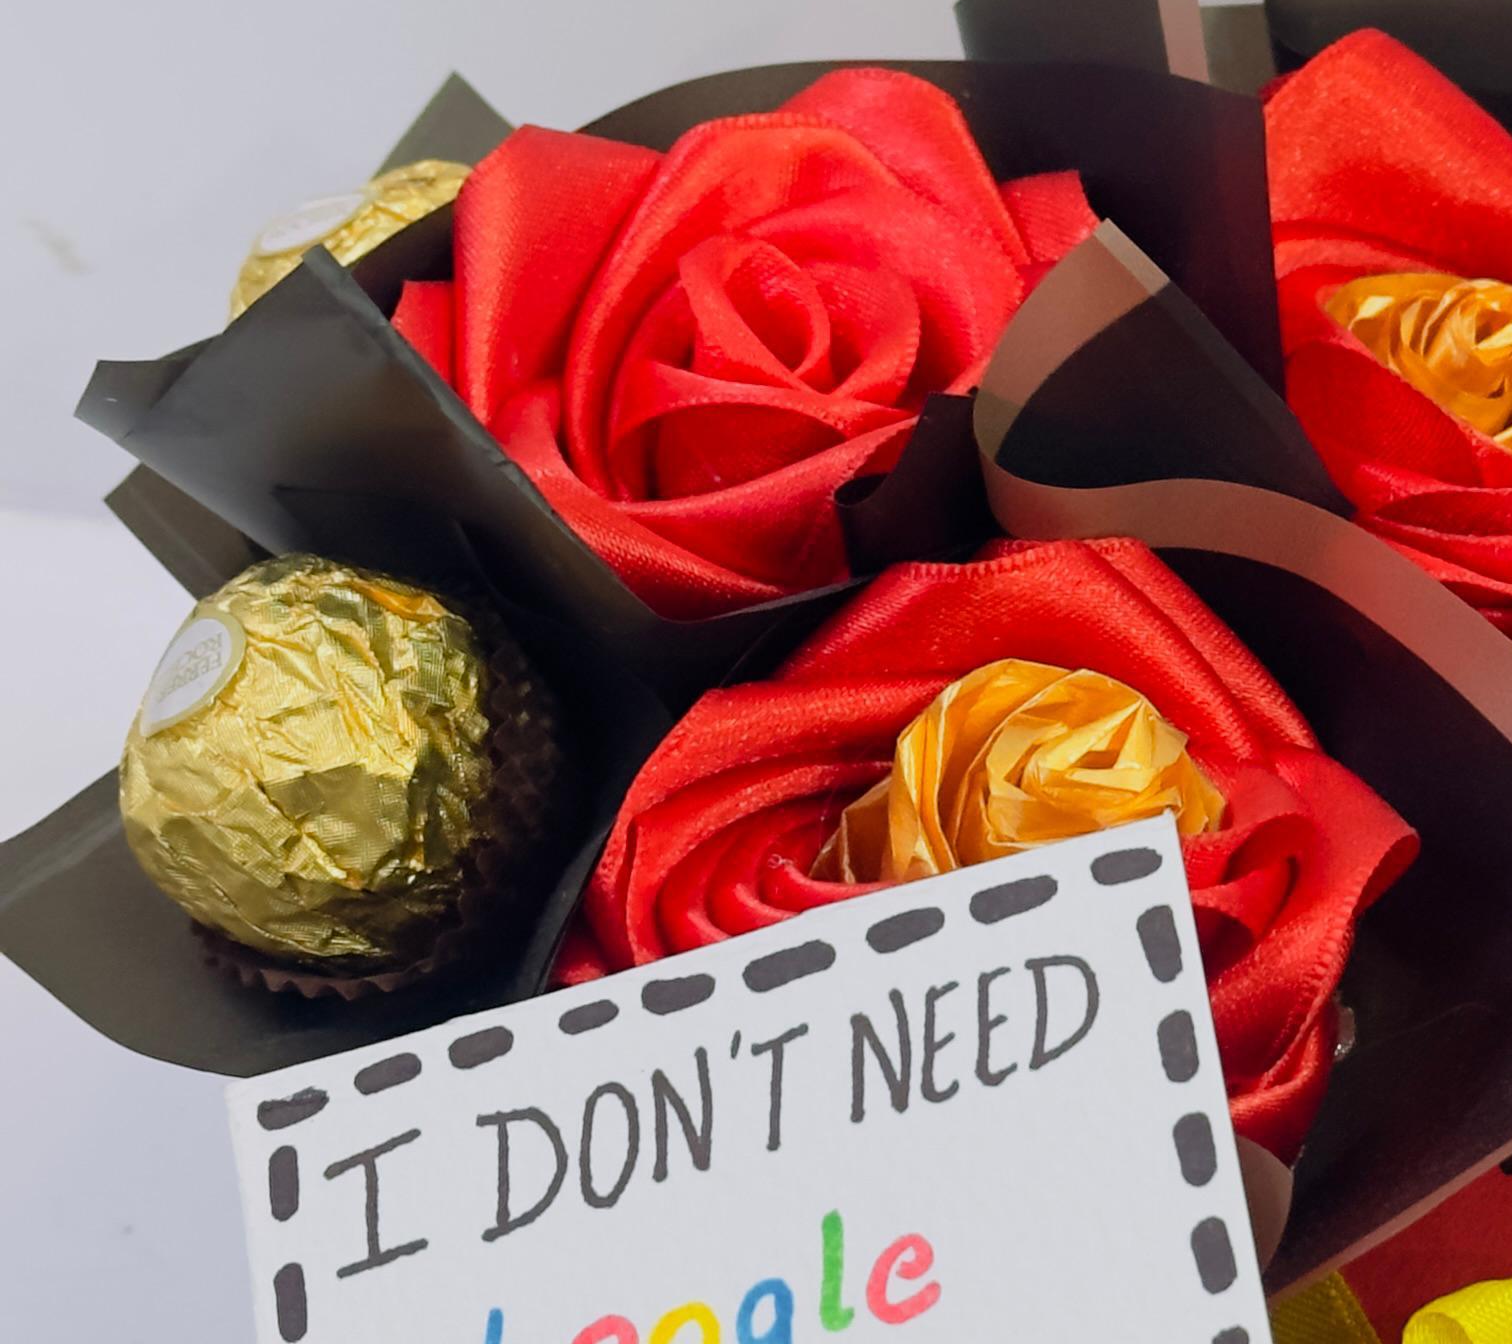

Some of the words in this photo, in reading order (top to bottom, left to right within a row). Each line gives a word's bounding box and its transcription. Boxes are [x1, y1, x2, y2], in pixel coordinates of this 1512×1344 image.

[324, 1129, 428, 1279] I
[477, 1024, 808, 1242] DON'T
[851, 956, 1099, 1123] NEED
